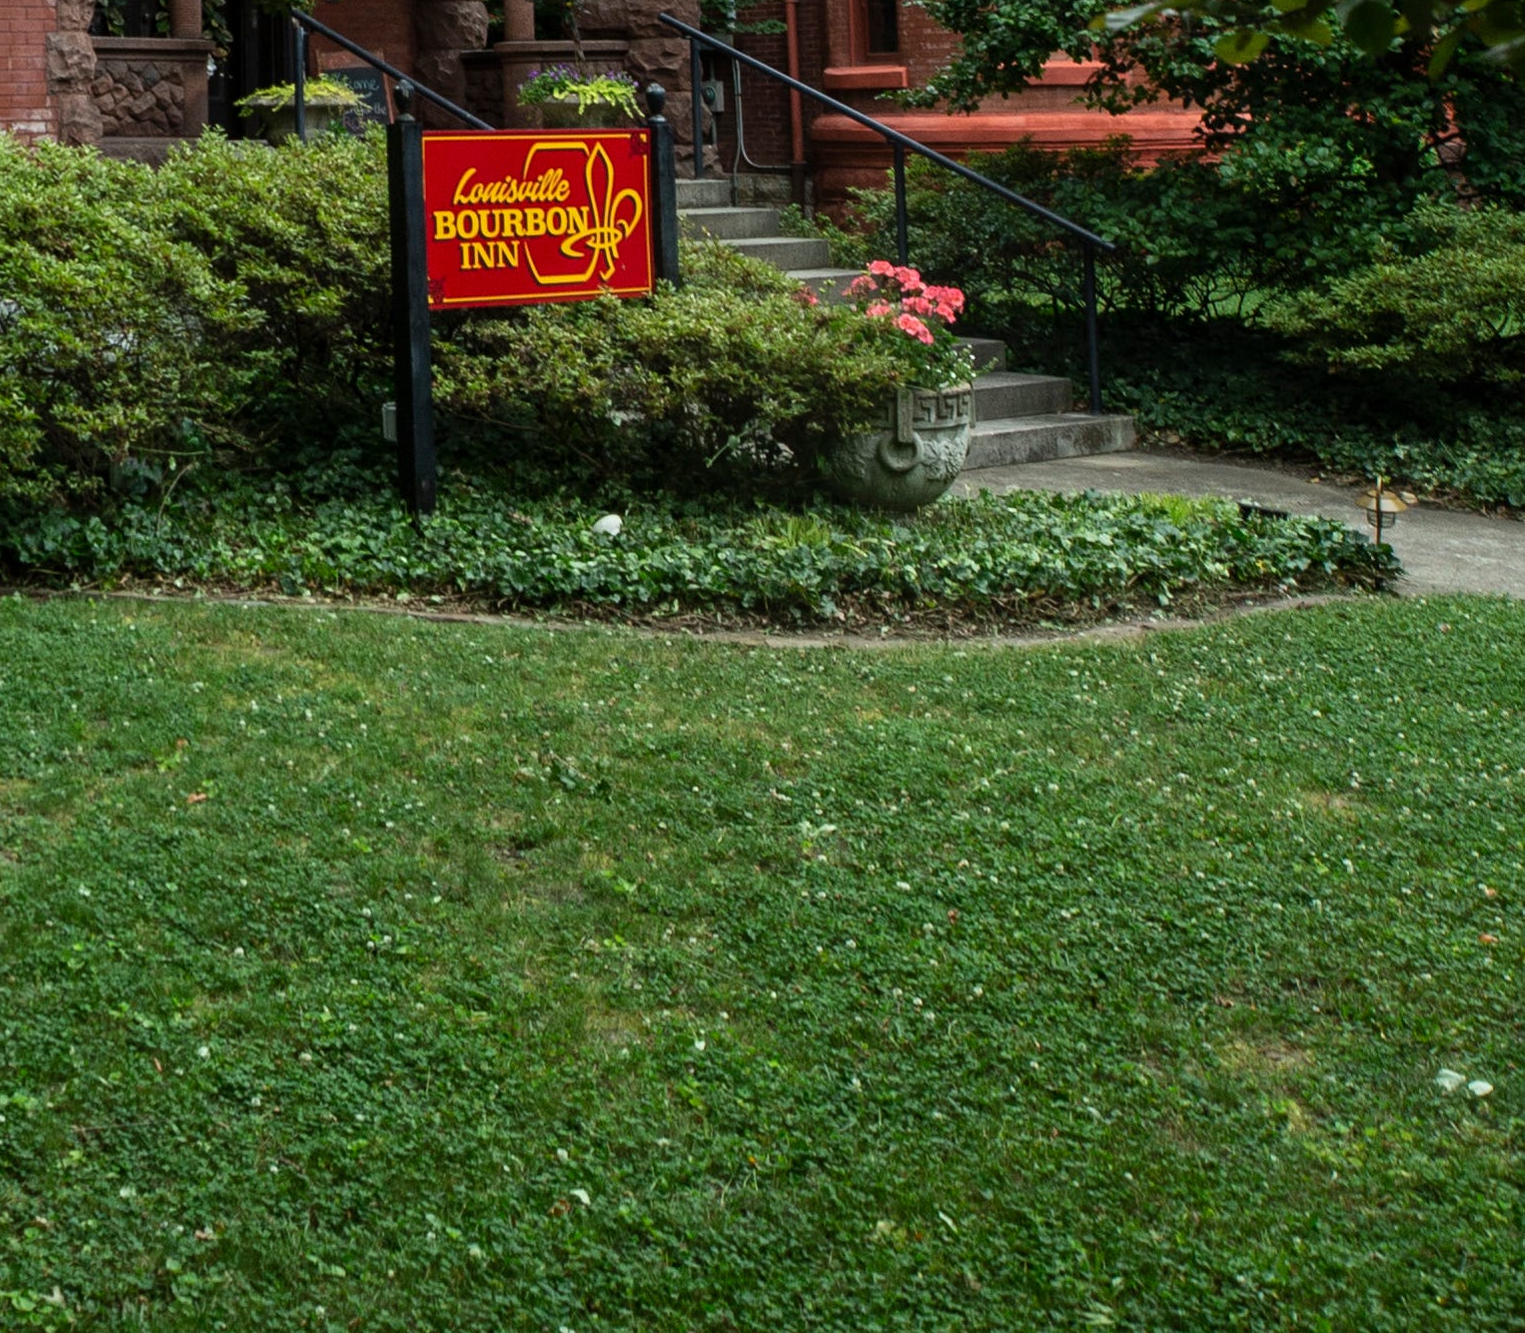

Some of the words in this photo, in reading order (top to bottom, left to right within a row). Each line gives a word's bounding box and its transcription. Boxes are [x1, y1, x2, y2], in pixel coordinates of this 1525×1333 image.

[454, 168, 570, 205] Louisville
[433, 206, 589, 240] BOURBON
[460, 241, 520, 269] INN
